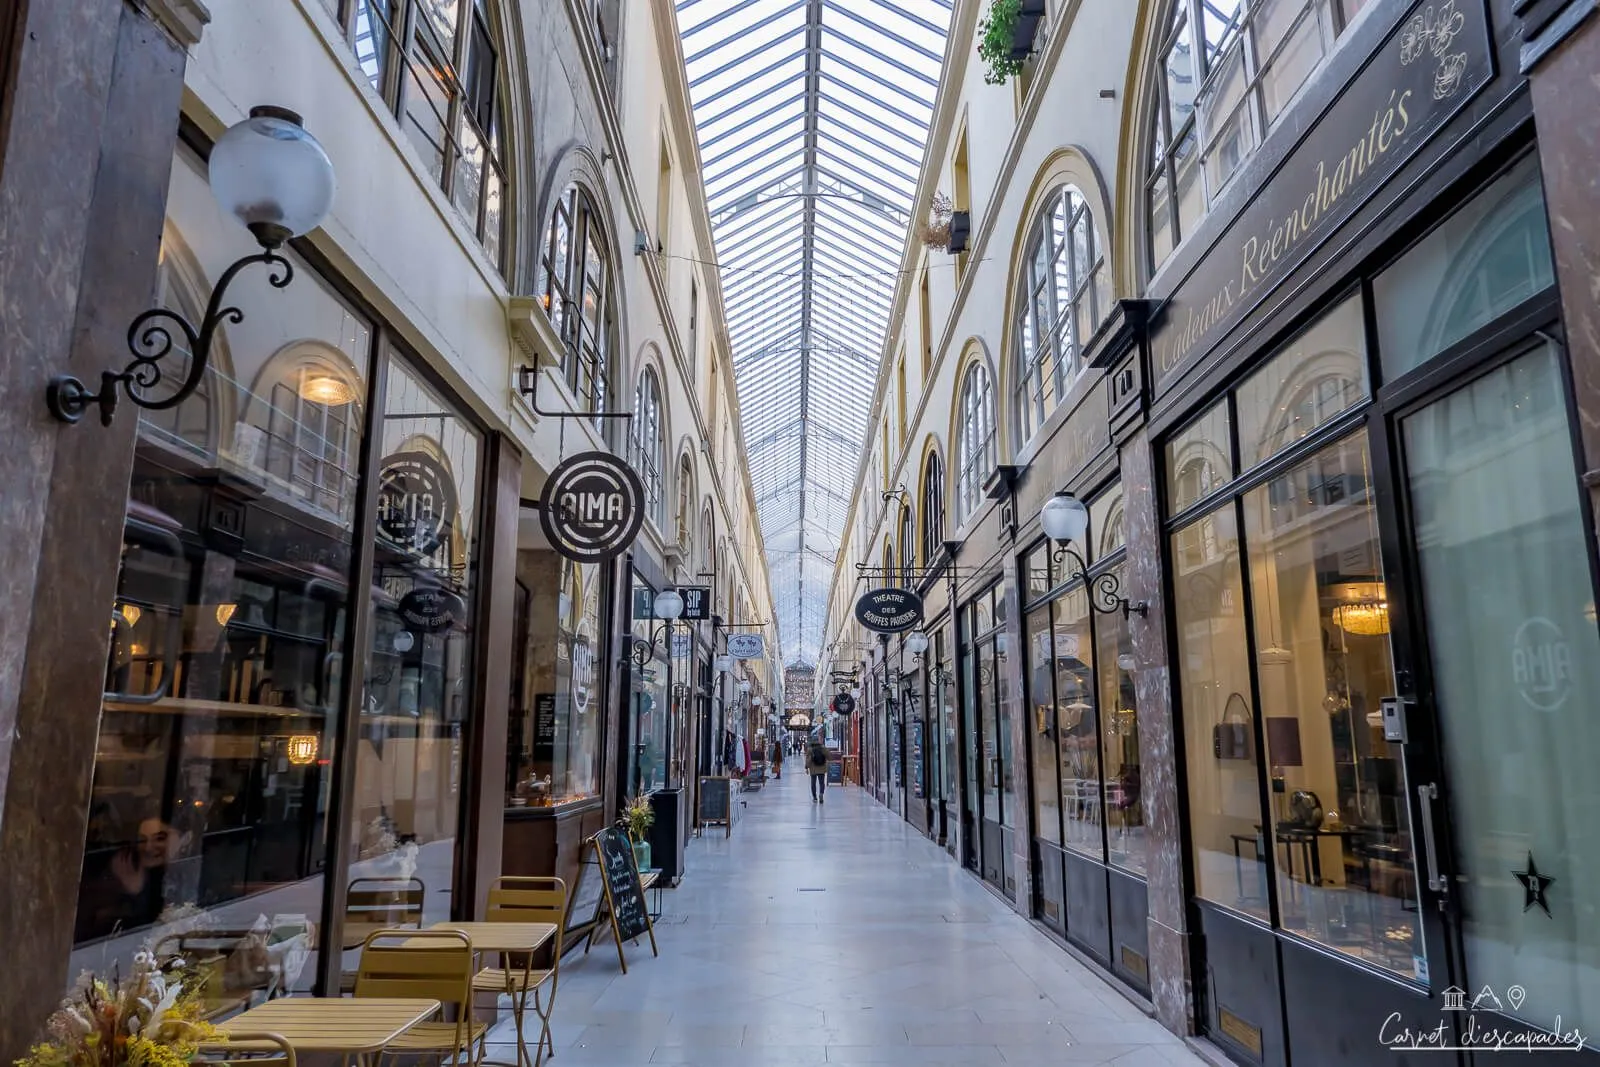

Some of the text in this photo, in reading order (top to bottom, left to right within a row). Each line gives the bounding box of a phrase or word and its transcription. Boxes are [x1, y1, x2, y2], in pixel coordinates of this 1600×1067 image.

[1161, 89, 1411, 372] Cadeaux Réenchantés
[873, 594, 905, 604] THEATRE
[863, 609, 917, 627] BOUFFES PARISIENS
